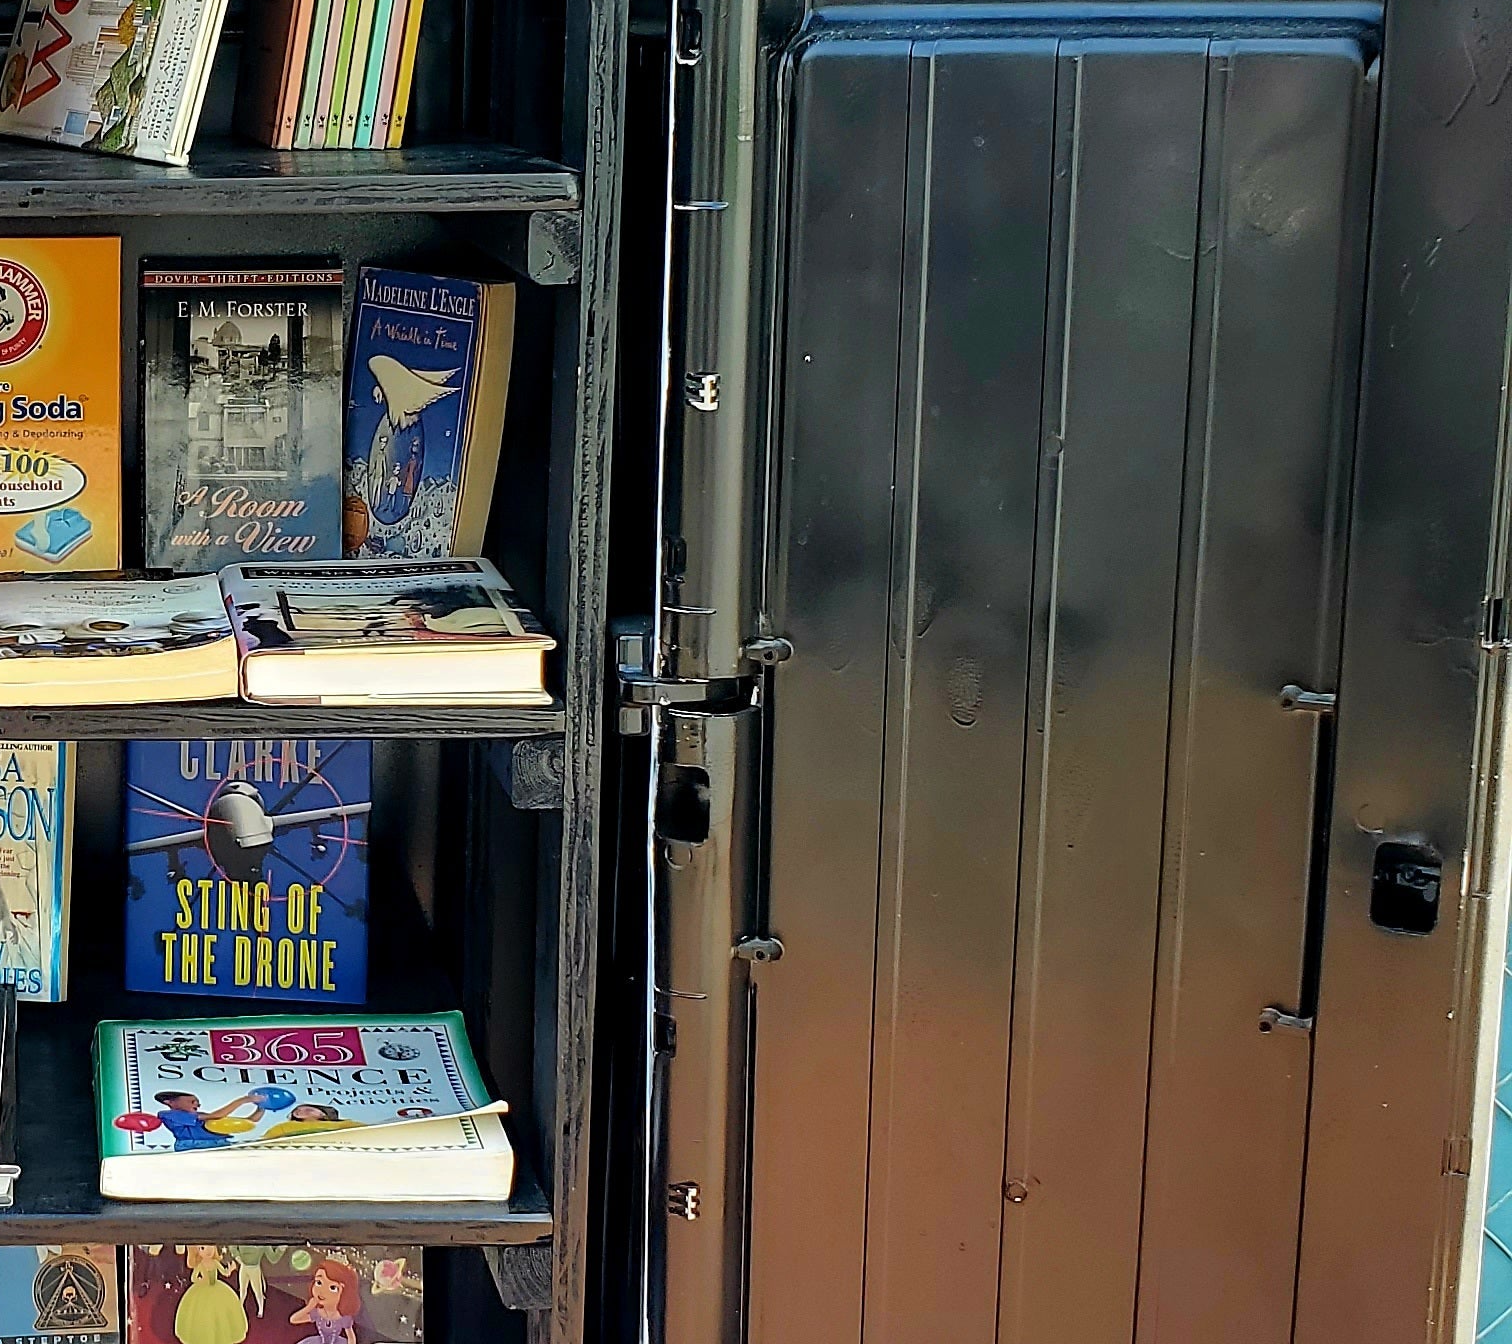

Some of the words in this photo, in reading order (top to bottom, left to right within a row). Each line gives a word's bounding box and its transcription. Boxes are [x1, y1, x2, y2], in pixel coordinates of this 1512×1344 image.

[177, 302, 193, 318] E.
[199, 301, 221, 318] M.
[227, 301, 309, 318] FORSTER
[363, 278, 427, 310] MADELEINE
[429, 287, 475, 317] L'ENGLE
[11, 395, 82, 421] Soda
[1, 454, 49, 477] 100
[176, 486, 208, 508] A
[200, 486, 308, 521] Room
[171, 532, 212, 547] with
[216, 535, 227, 546] a
[234, 521, 316, 554] View
[180, 740, 323, 784] CLARKE
[176, 878, 270, 932] STING
[288, 884, 324, 935] OF
[161, 933, 217, 984] THE
[234, 936, 337, 990] DRONE
[220, 1031, 354, 1064] 365
[157, 1064, 432, 1085] SCIENCE
